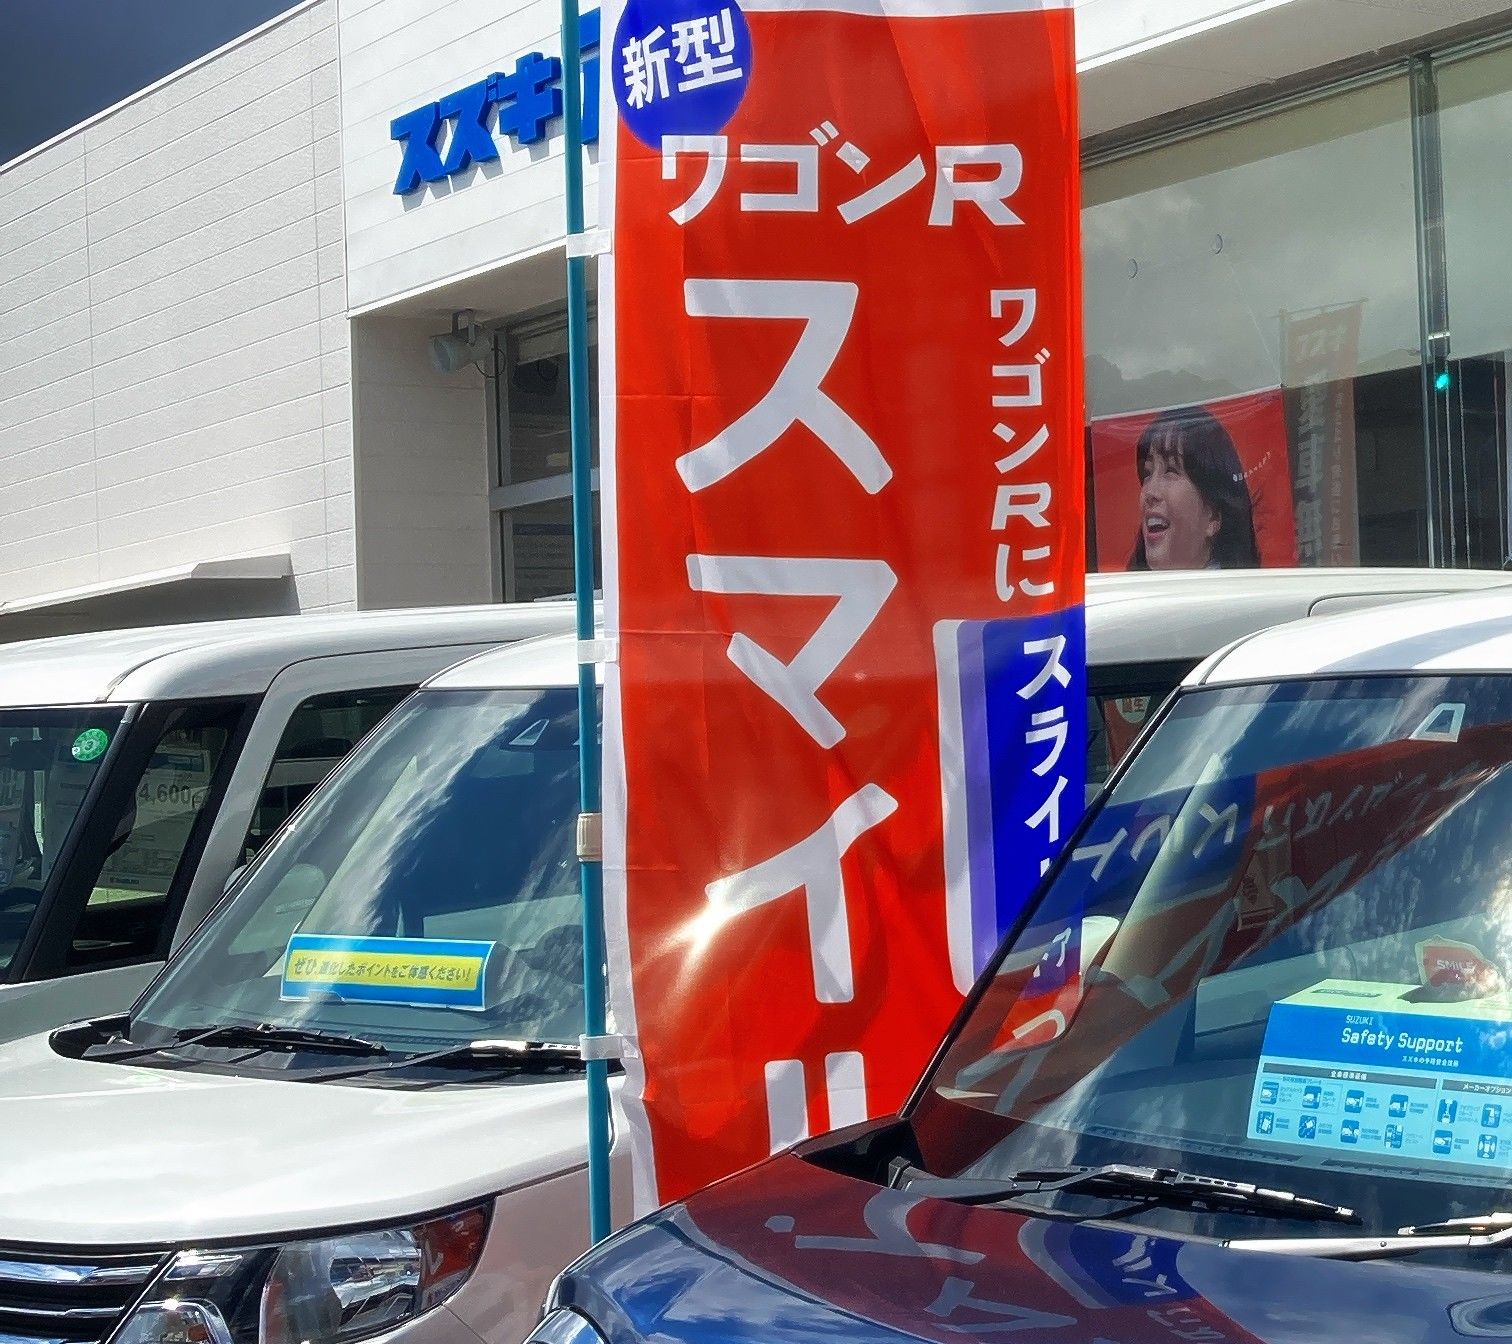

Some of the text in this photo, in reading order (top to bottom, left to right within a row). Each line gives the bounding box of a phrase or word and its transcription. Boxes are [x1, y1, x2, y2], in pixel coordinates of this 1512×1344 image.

[622, 7, 744, 110] 新型
[659, 120, 1025, 226] ワゴンR
[989, 289, 1054, 601] ワゴンRに
[1016, 635, 1071, 878] スライ
[1341, 1027, 1464, 1054] Safety Support
[1346, 1014, 1374, 1026] SUZUKI
